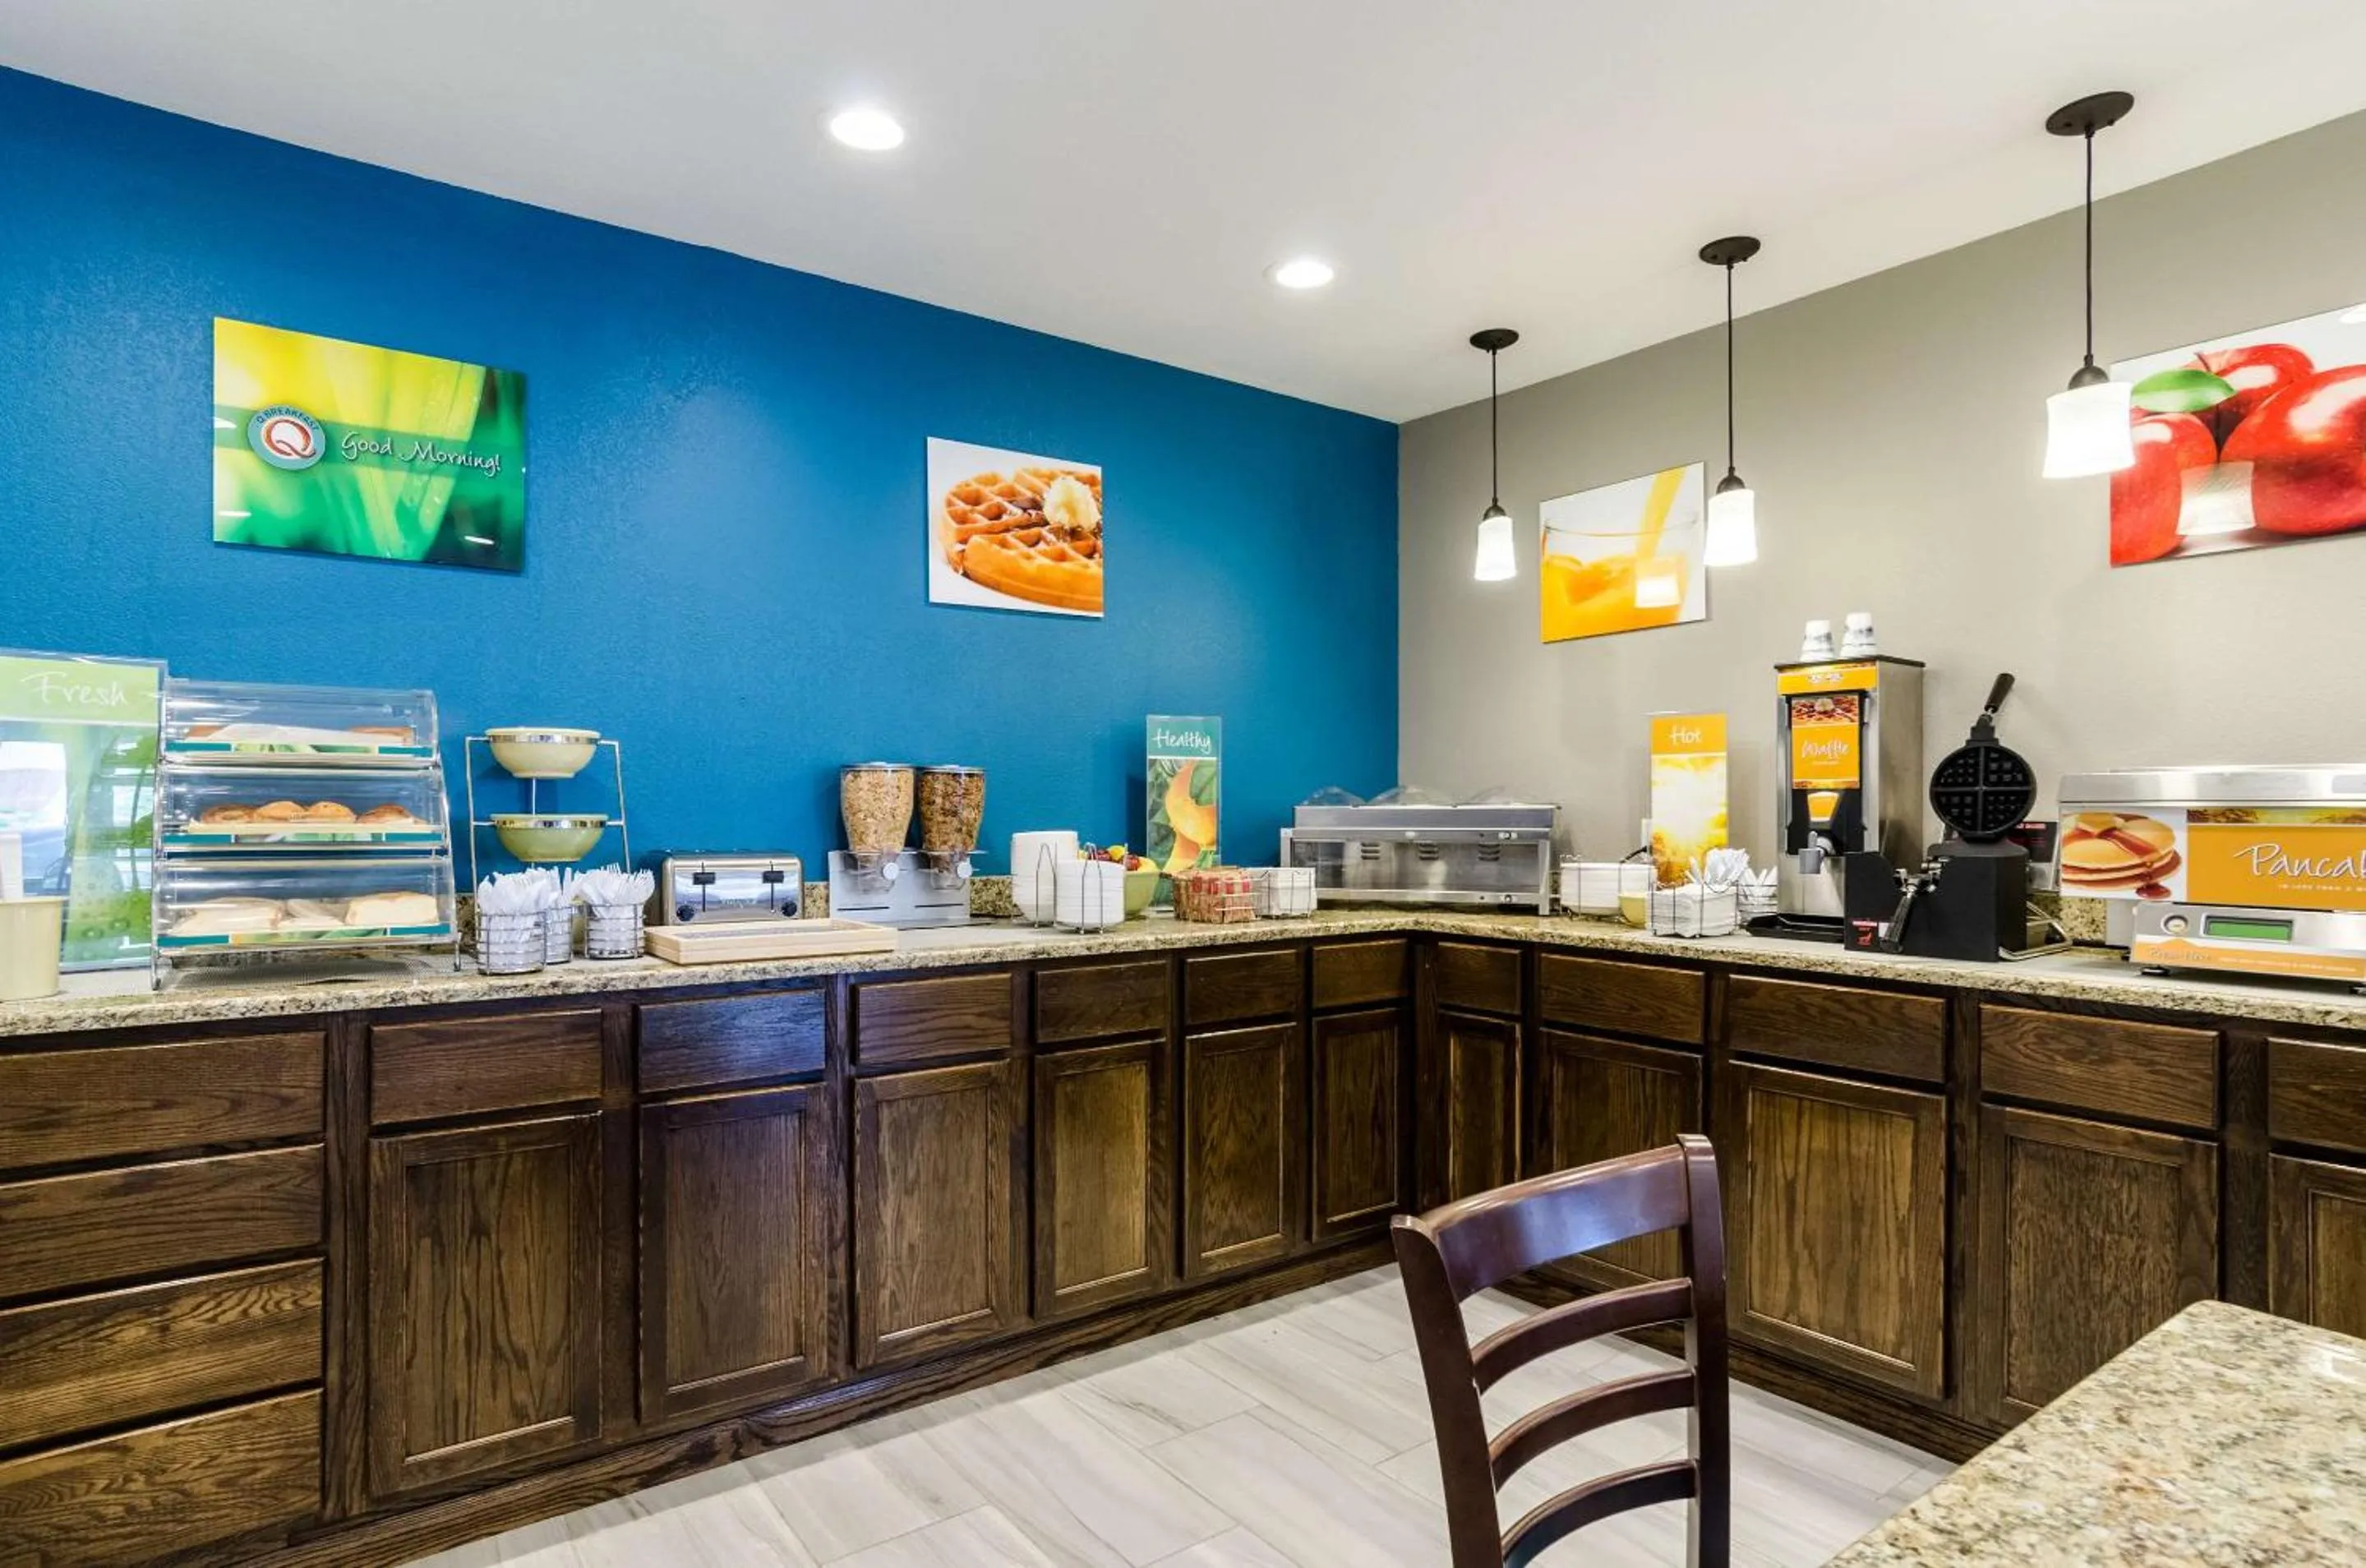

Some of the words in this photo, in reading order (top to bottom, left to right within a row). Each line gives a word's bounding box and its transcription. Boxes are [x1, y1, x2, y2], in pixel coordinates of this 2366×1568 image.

[341, 431, 392, 460] Good
[400, 440, 501, 477] Morning!
[20, 671, 128, 707] Fresh
[1152, 727, 1211, 754] Healthy
[1669, 724, 1703, 746] Hot
[1801, 739, 1849, 760] Waffle
[2233, 842, 2366, 879] Panca
